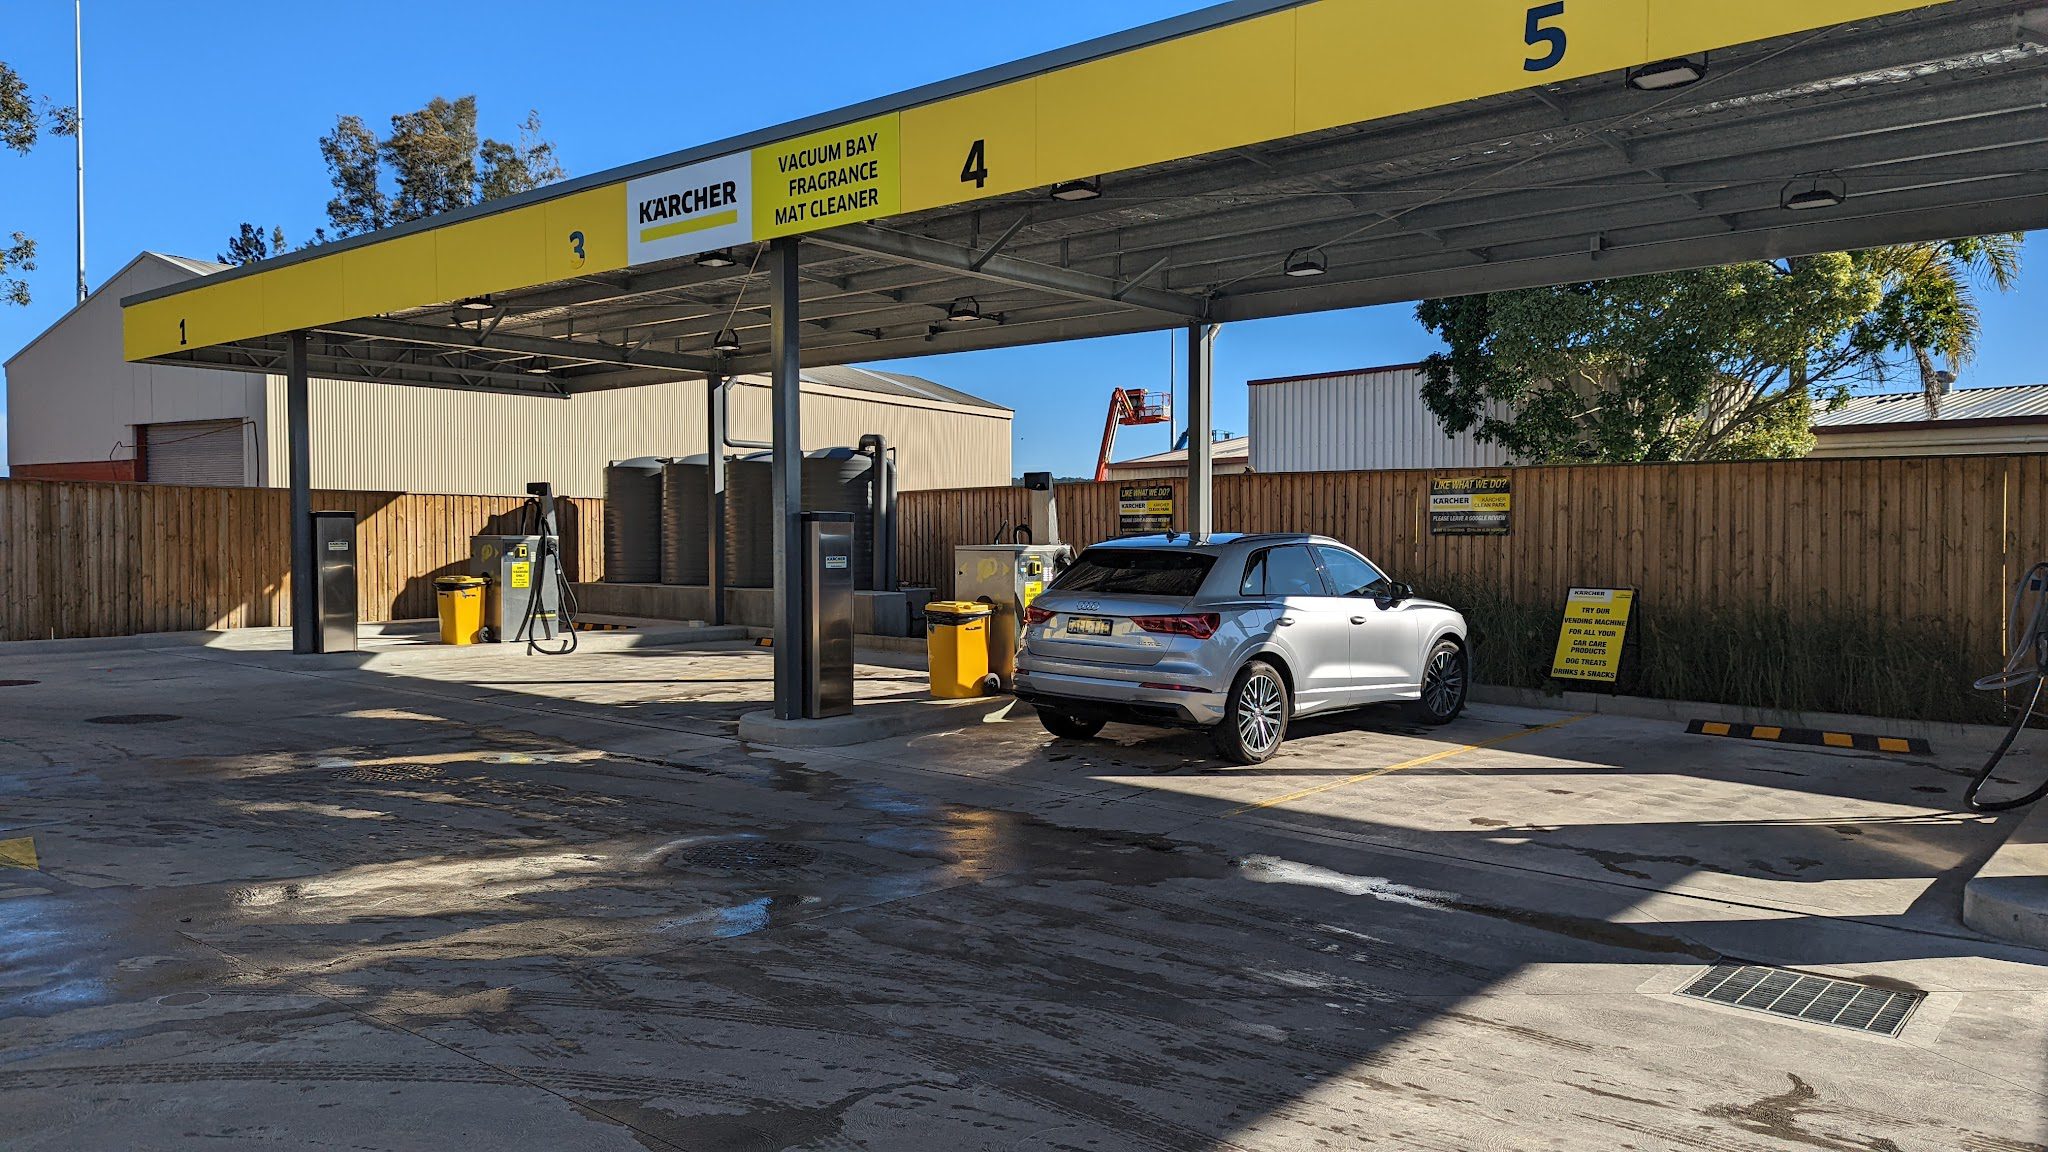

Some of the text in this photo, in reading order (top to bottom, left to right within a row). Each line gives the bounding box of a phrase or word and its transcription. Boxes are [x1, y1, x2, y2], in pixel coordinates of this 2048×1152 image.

[1523, 1, 1566, 71] 5
[778, 133, 878, 173] VACUUM BAY
[960, 139, 988, 188] 4
[789, 160, 878, 196] FRAGRANCE
[640, 180, 737, 224] KÄRCHER
[775, 188, 878, 225] MAT CLEANER
[569, 230, 585, 269] 3
[180, 319, 187, 345] 1
[1434, 479, 1507, 490] LIKE WHAT WE DO?
[1571, 647, 1606, 655] PRODUCTS
[1581, 658, 1607, 666] TREATS
[1554, 668, 1578, 676] DRINKS
